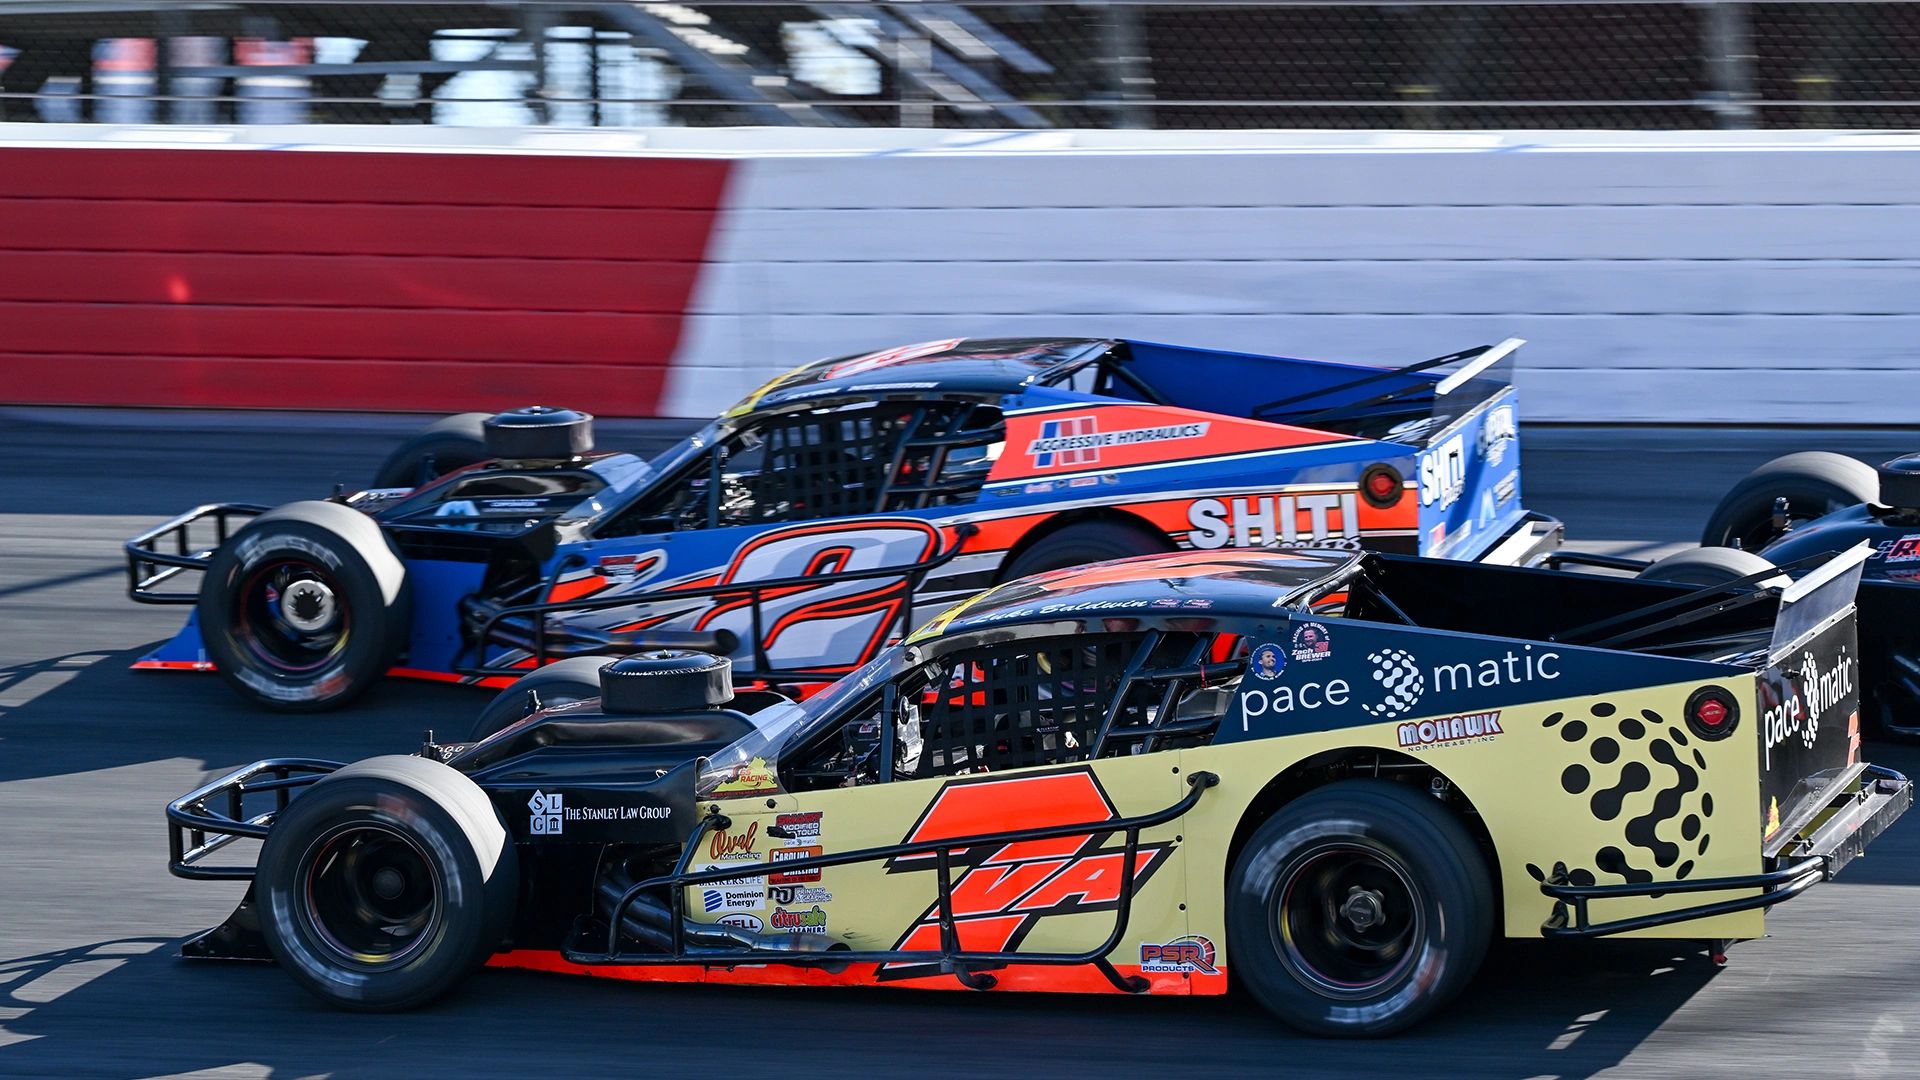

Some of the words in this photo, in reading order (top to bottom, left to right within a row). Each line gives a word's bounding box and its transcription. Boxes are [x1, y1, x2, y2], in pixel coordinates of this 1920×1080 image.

[1032, 433, 1112, 453] AGGRESSIVE
[965, 608, 1034, 625] Luke
[1039, 600, 1149, 615] Baldwin
[1291, 648, 1314, 656] Zach
[1295, 651, 1332, 661] BREWER
[1240, 677, 1350, 731] pace
[1433, 644, 1561, 692] matic
[1764, 694, 1800, 771] pace
[1819, 645, 1852, 713] matic
[1398, 712, 1503, 746] MOHAWK
[740, 774, 768, 783] RACING
[564, 807, 581, 820] THE
[582, 806, 619, 820] STANLEY
[620, 806, 638, 819] LAW
[639, 805, 672, 819] GROUP
[720, 852, 762, 860] Marketing
[725, 891, 764, 900] Dominion
[1142, 945, 1217, 973] PSR
